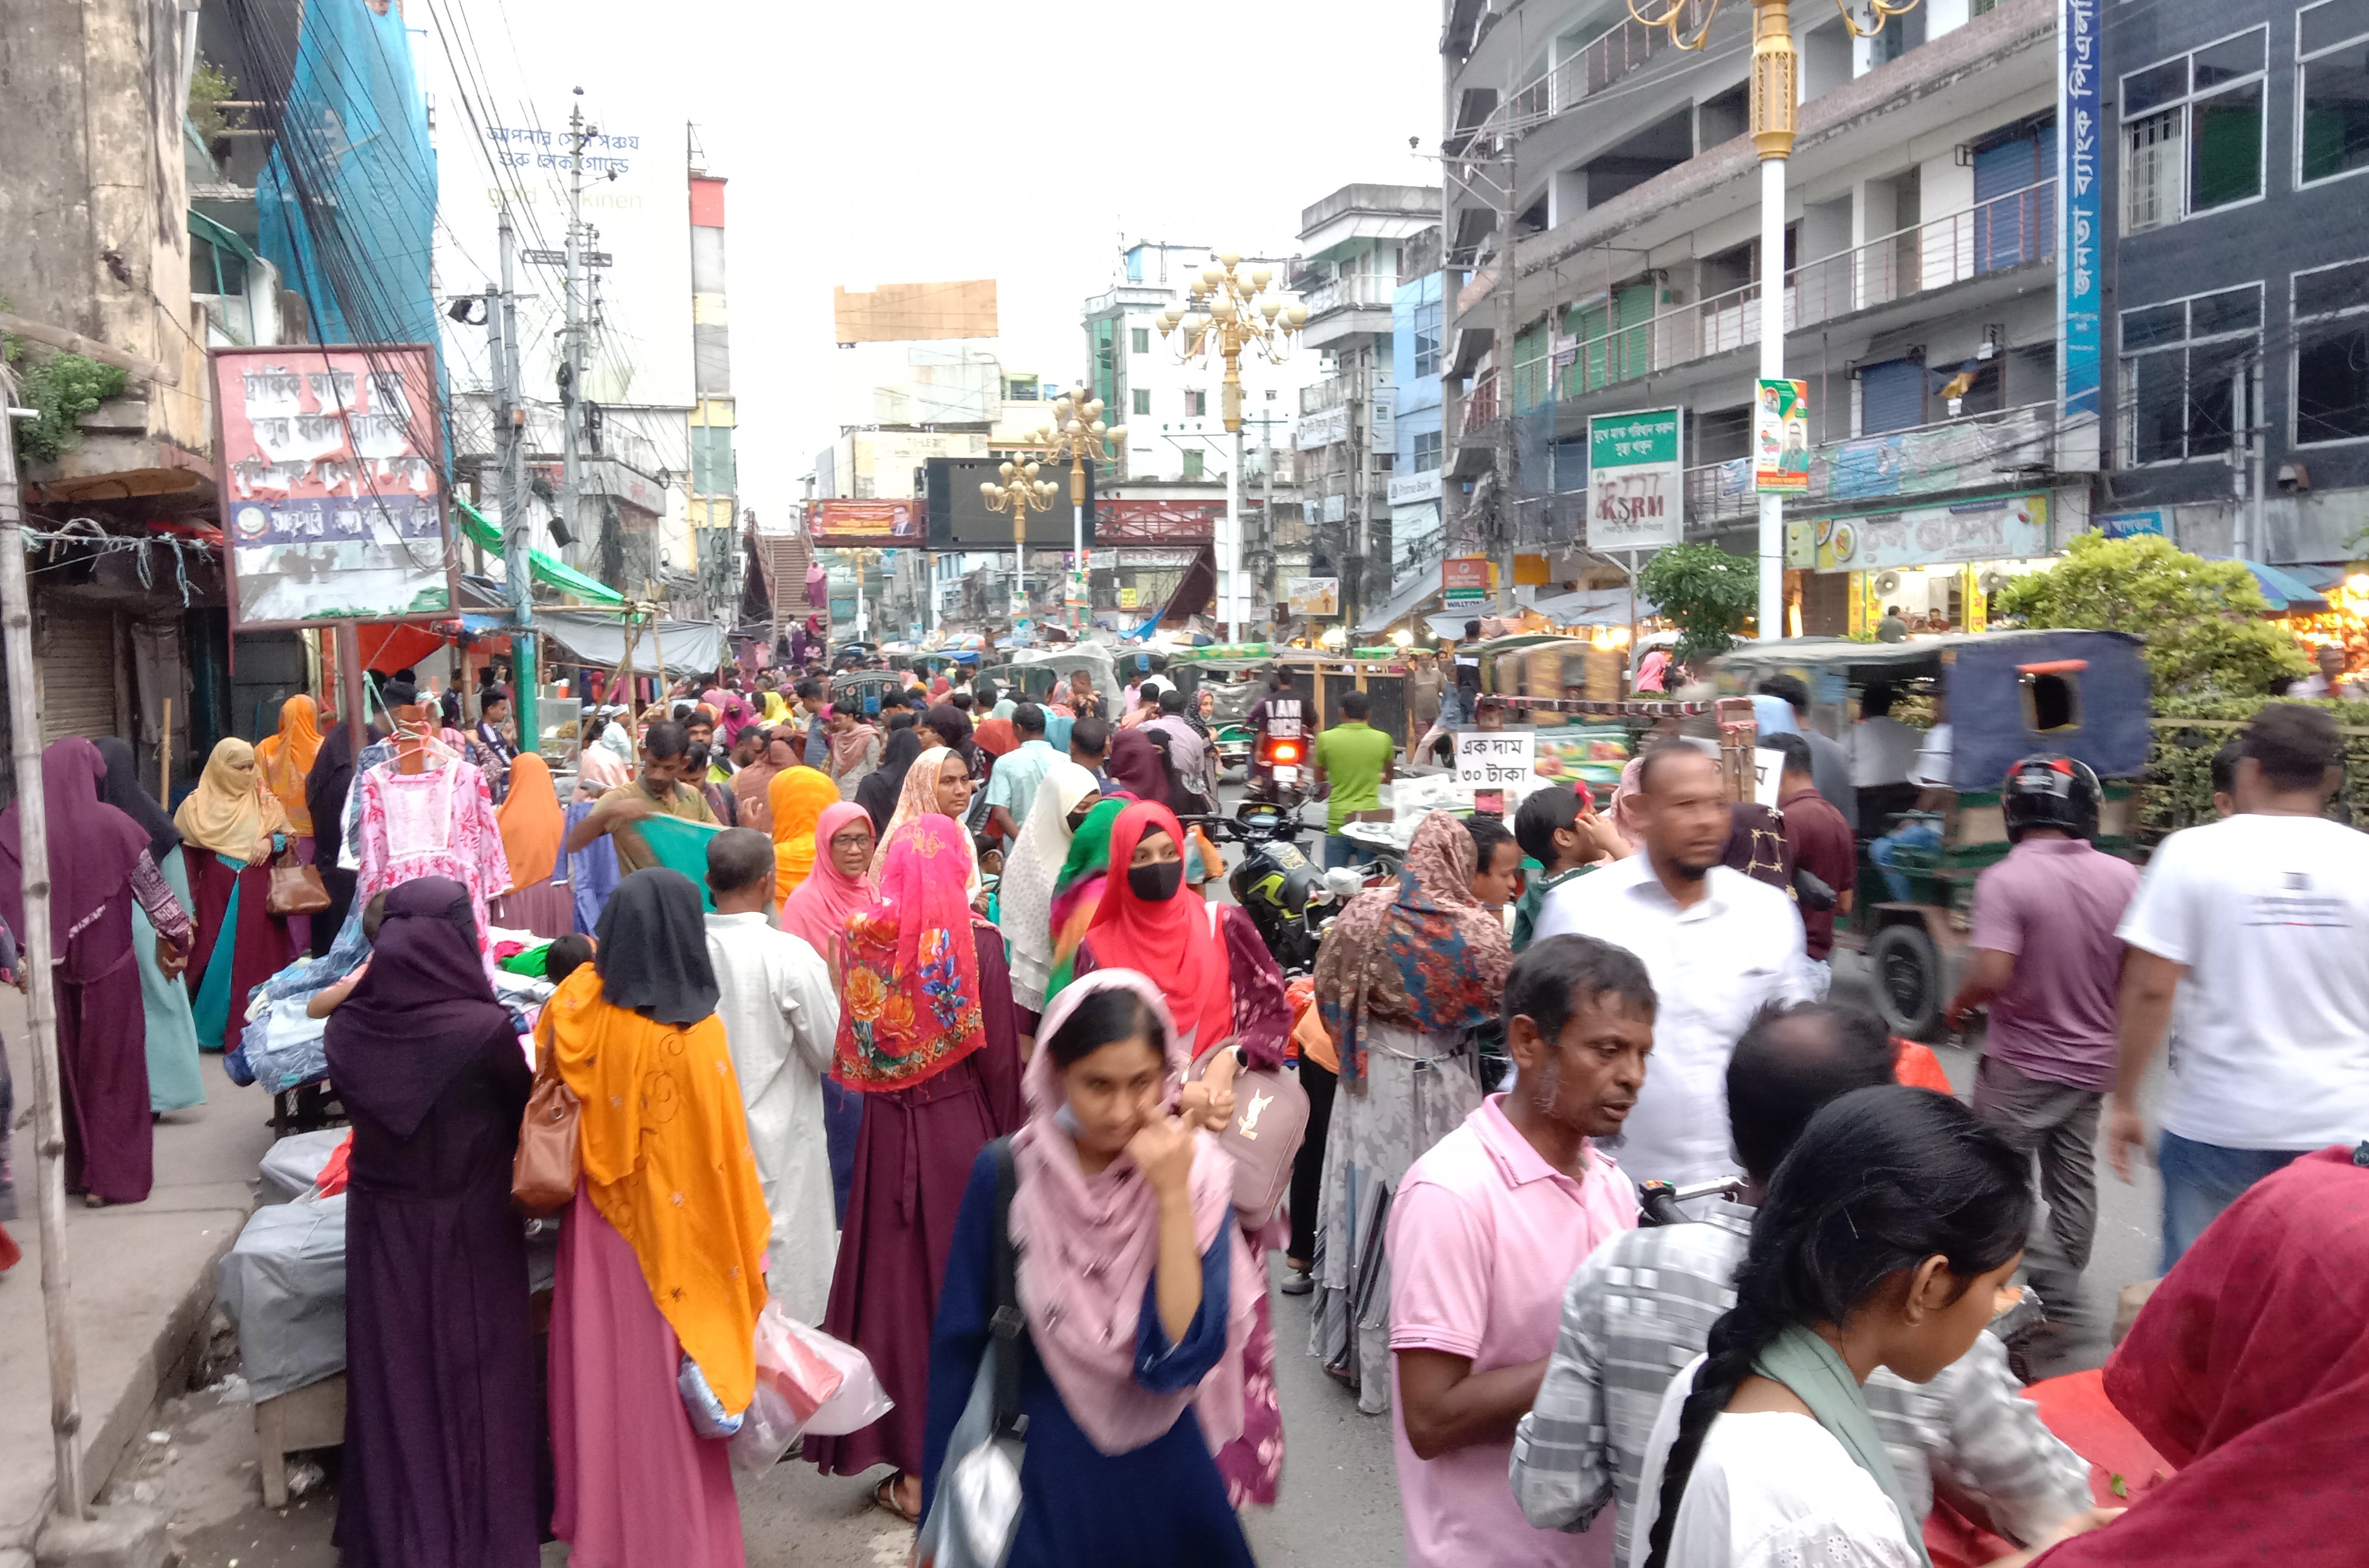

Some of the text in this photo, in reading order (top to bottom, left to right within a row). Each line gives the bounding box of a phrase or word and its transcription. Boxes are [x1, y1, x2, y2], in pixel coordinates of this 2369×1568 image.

[486, 126, 551, 146] আপনার
[2072, 106, 2094, 199] ব্যাংক
[2073, 206, 2094, 299] জনতা
[1602, 495, 1663, 522] KSRM
[1462, 739, 1524, 756] এক দাম
[1461, 762, 1527, 783] ৩০ টাকা
